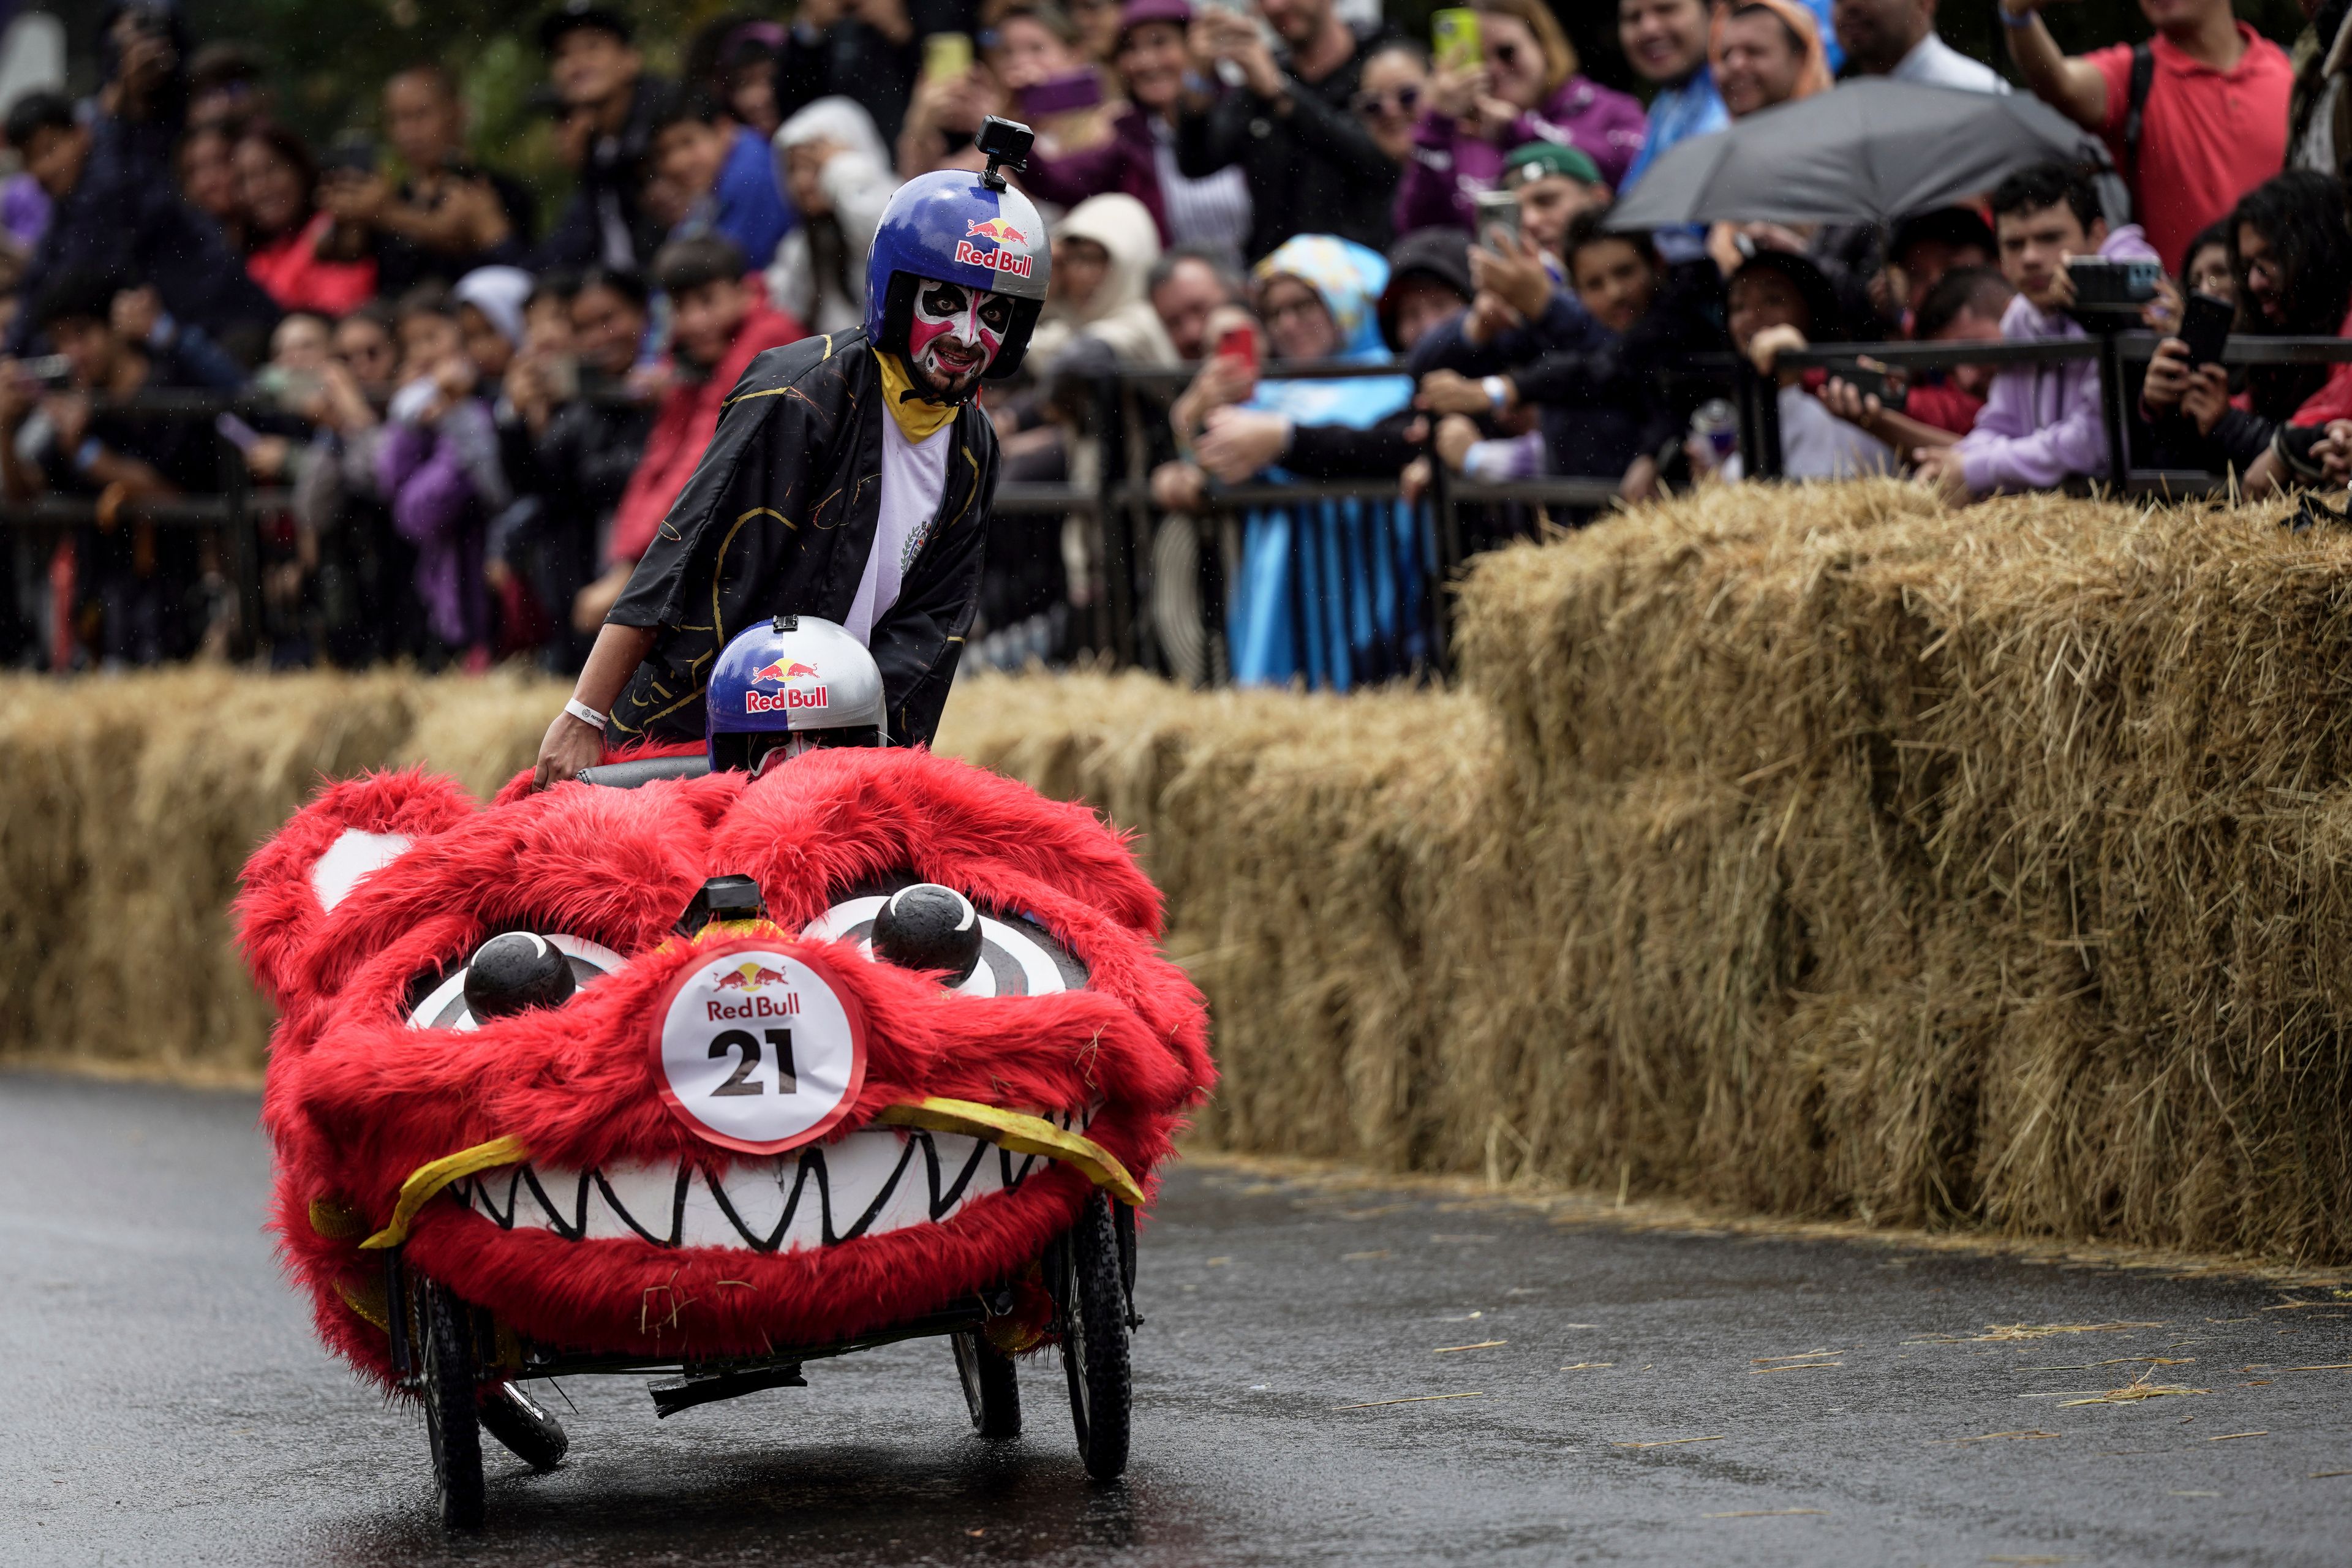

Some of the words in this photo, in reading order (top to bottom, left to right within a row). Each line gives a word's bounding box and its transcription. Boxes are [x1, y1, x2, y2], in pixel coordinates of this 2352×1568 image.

[957, 242, 998, 268] Red
[999, 252, 1031, 277] Bull
[747, 689, 785, 712] Red
[788, 687, 827, 708] Bull
[707, 997, 752, 1022] Red
[757, 993, 801, 1017] Bull
[708, 1029, 797, 1097] 21
